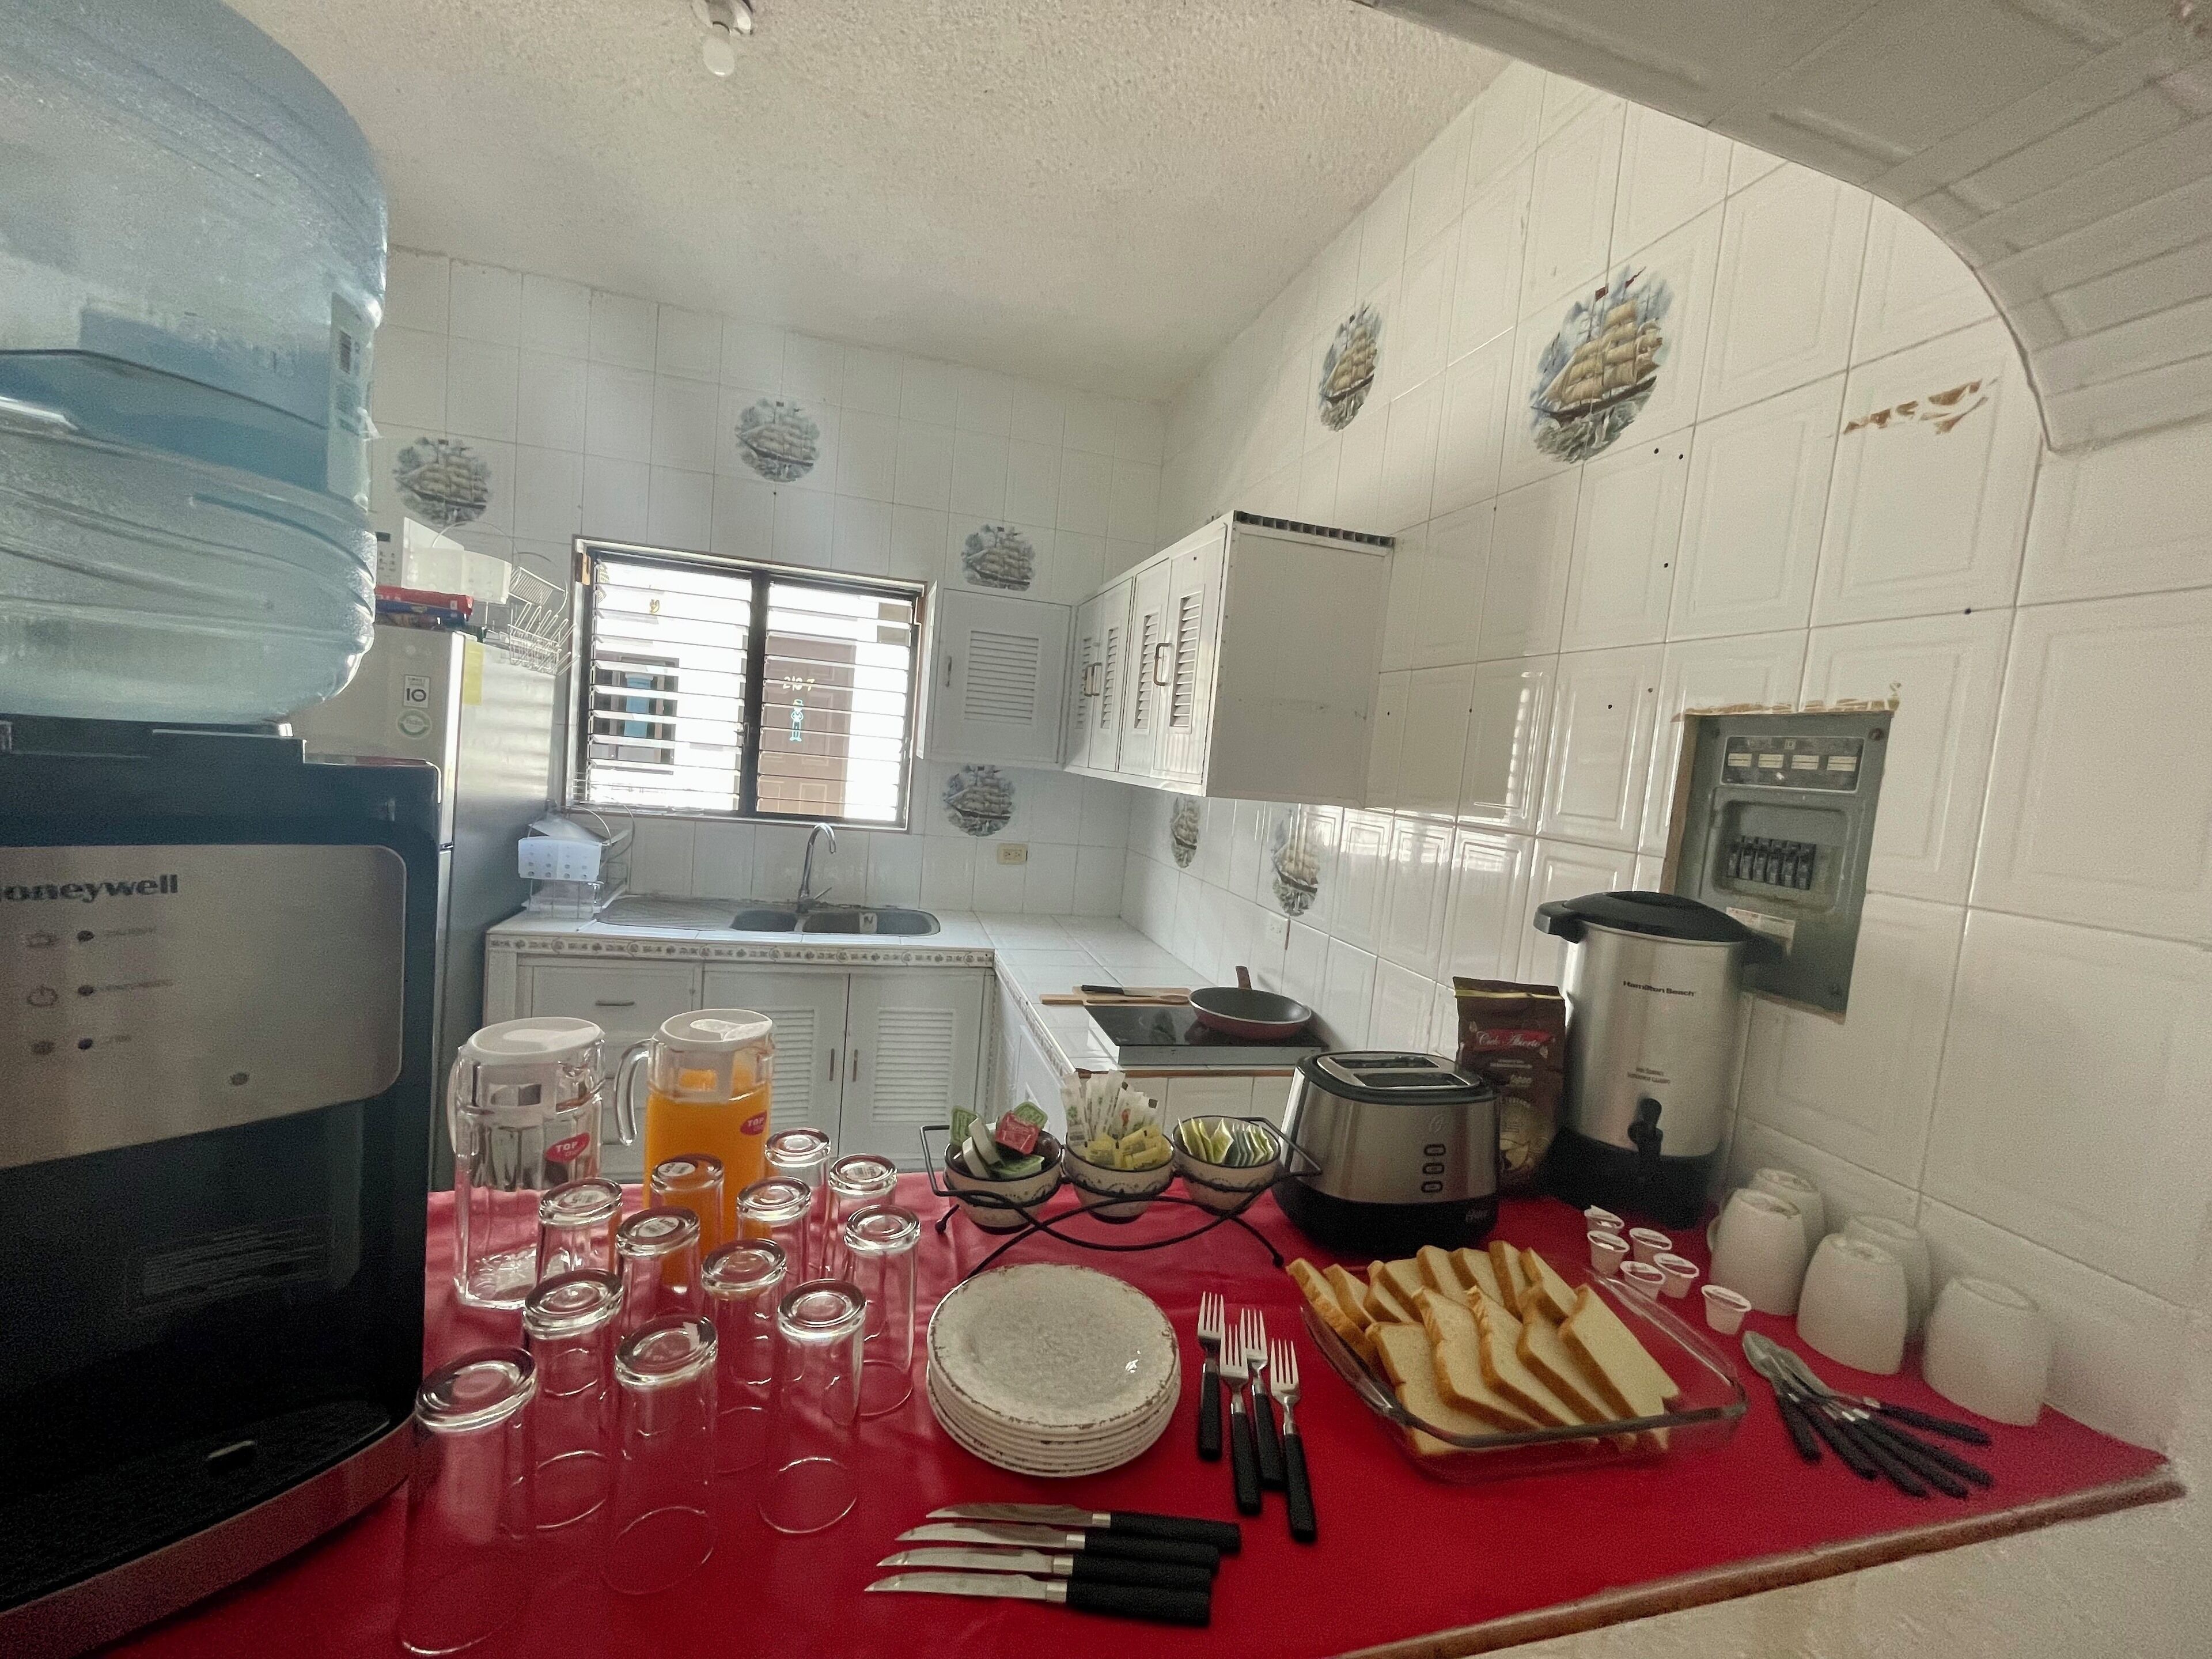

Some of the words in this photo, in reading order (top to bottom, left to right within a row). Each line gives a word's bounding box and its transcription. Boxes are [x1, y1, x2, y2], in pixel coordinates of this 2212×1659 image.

[0, 874, 178, 903] oneywell
[1666, 988, 1695, 997] Beach
[747, 1117, 764, 1127] TOP
[555, 1141, 578, 1153] TOP
